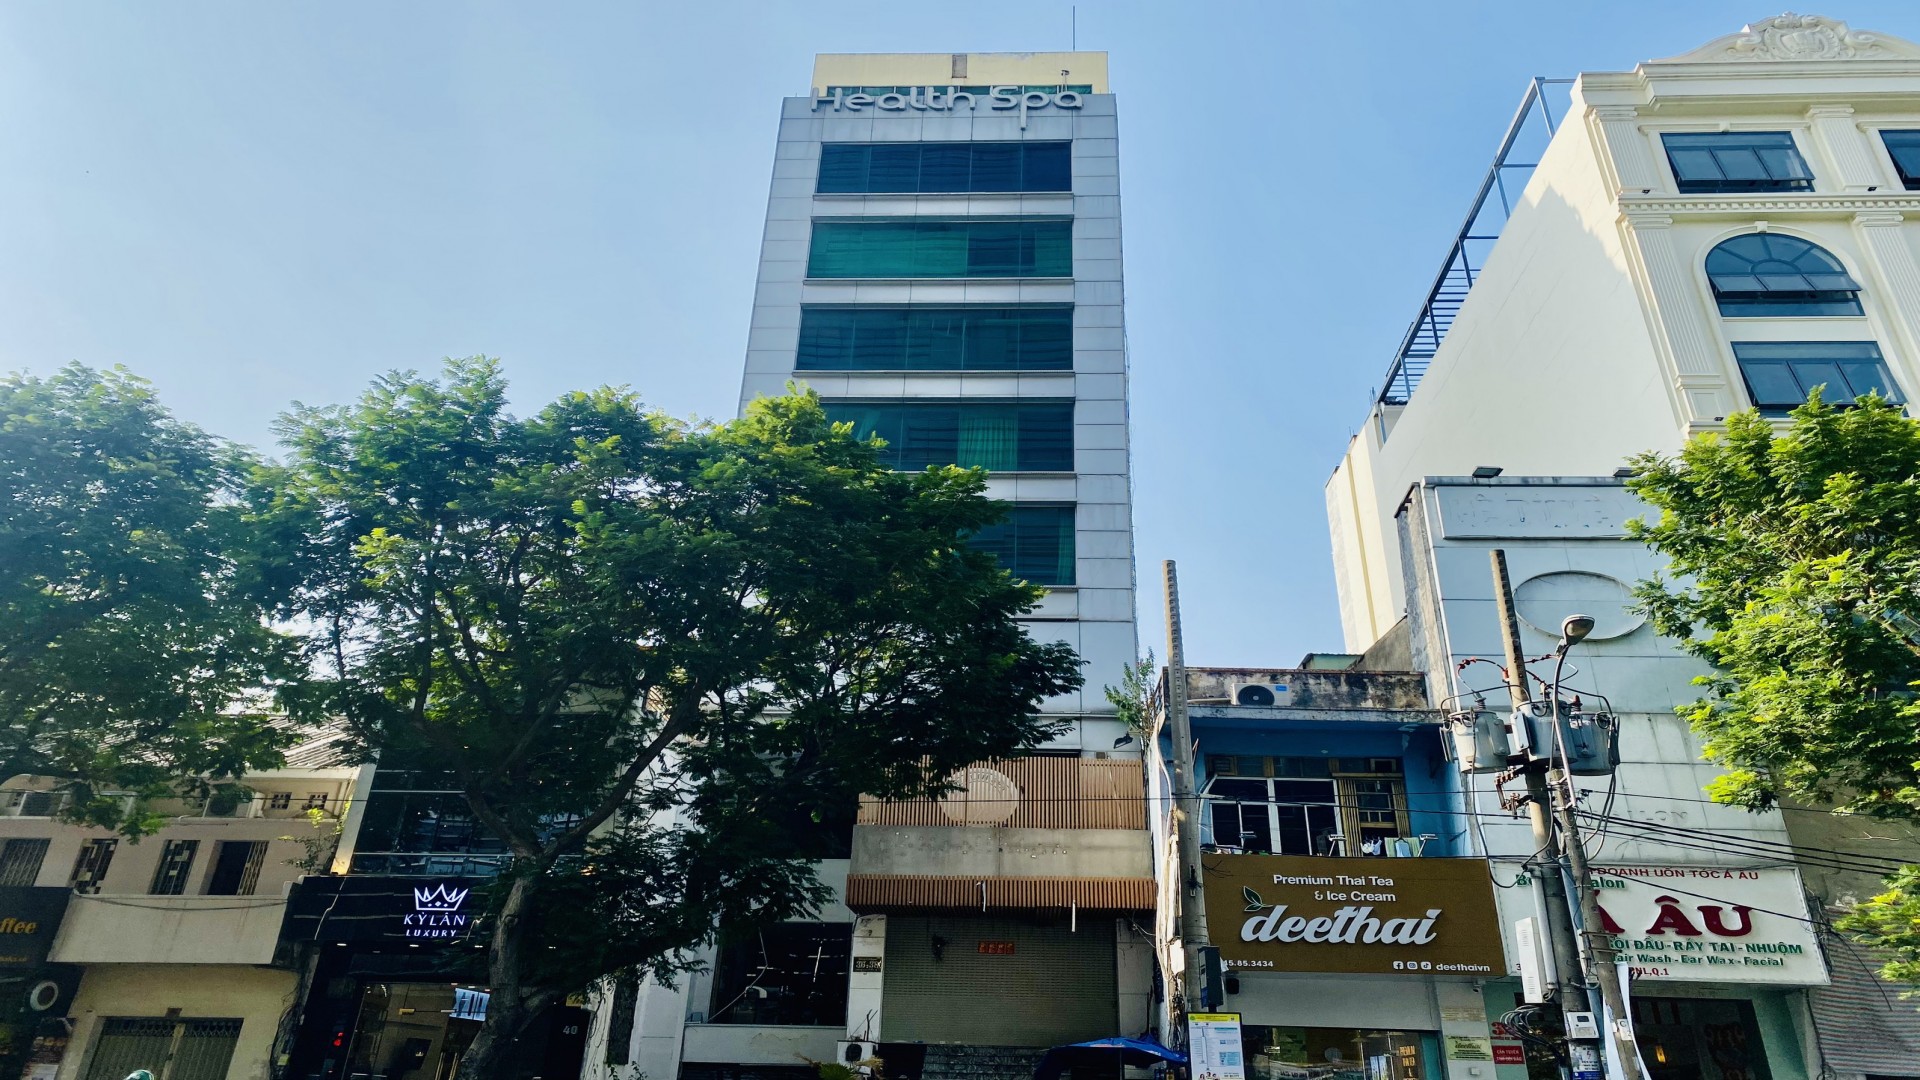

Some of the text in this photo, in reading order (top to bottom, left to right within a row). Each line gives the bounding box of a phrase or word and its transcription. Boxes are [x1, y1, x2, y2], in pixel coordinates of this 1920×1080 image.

[811, 85, 1083, 131] Health Spa
[1273, 874, 1394, 886] Premium Thai Tea
[1592, 877, 1625, 888] alon
[1314, 890, 1396, 901] & Ice Cream
[1241, 905, 1442, 945] deethai
[1709, 943, 1736, 952] TAI
[1637, 954, 1672, 963] Wash
[1681, 955, 1703, 963] Ear
[1706, 956, 1735, 964] Wax
[1744, 957, 1784, 966] Facial
[563, 1025, 579, 1035] 40
